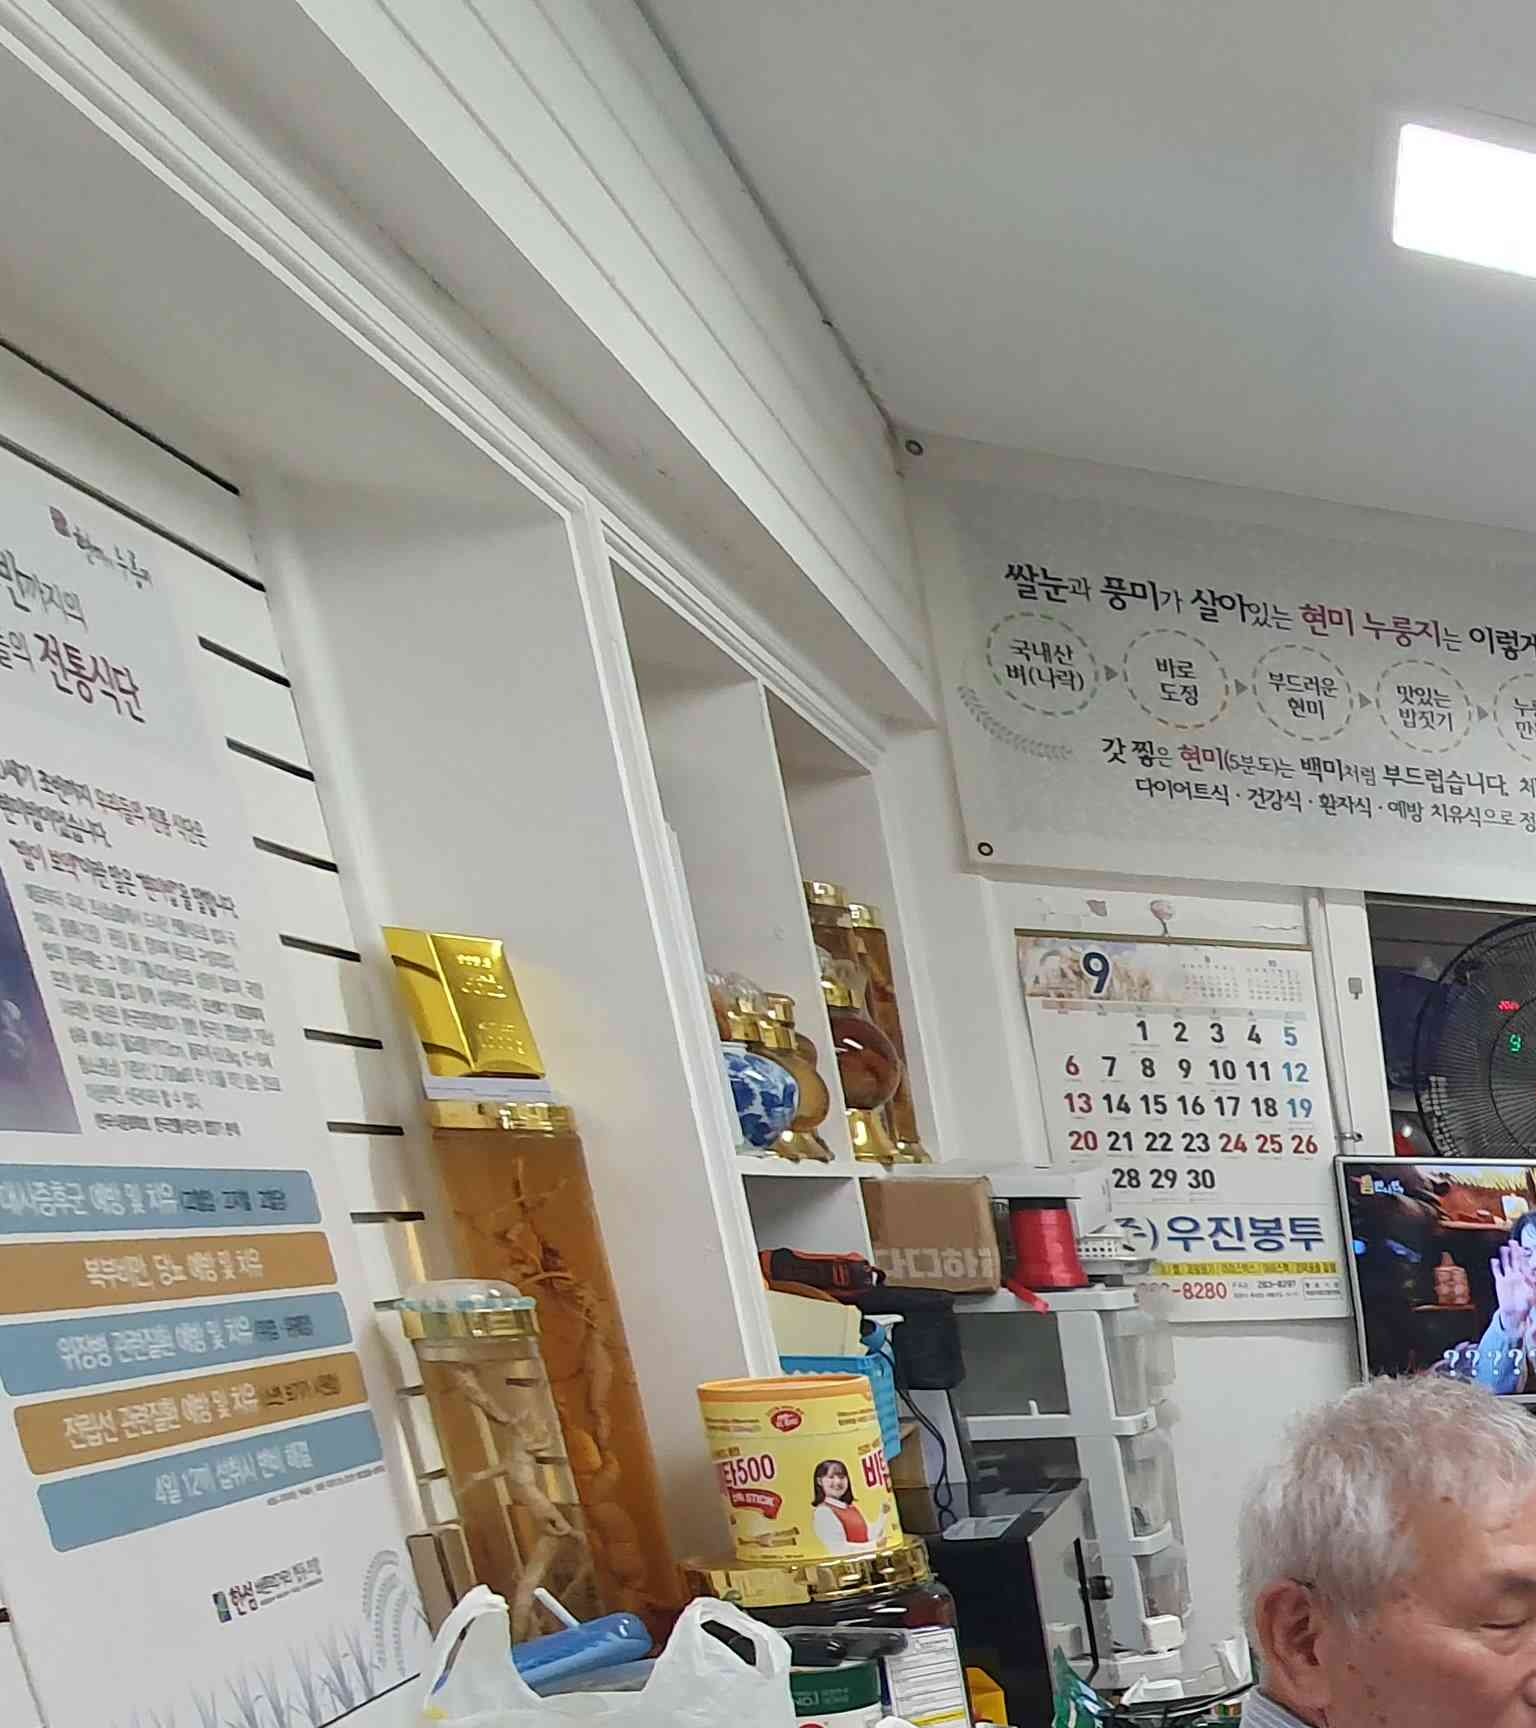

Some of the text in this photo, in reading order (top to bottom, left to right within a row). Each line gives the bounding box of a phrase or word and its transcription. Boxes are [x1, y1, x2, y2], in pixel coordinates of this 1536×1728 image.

[1004, 562, 1091, 604] 쌀눈과
[1100, 574, 1183, 615] 풍미가
[1189, 587, 1293, 632] 살아있는
[1300, 602, 1354, 638] 현미
[1362, 611, 1463, 653] 누룽지는
[1009, 639, 1074, 666] 국내산
[1005, 662, 1086, 693] 벼(나락)
[1154, 655, 1197, 682] 바로
[1159, 681, 1200, 707] 도정
[1267, 670, 1339, 699] 부드러운
[1395, 684, 1452, 709] 맛있는
[1286, 695, 1326, 721] 현미
[1398, 704, 1455, 733] 밥짓기
[1101, 737, 1127, 765] 갓
[1300, 756, 1377, 788] 백미처럼
[1382, 763, 1510, 798] 부드럽습니다.
[1135, 777, 1231, 807] 다이어트식
[1247, 786, 1303, 813] 건강식
[1318, 792, 1373, 819] 환자식
[1387, 799, 1425, 824] 예방
[1430, 803, 1517, 829] 치유식으로
[1082, 950, 1113, 995] 9
[1136, 1020, 1298, 1047] 1 2 3 4 5
[1065, 1055, 1308, 1084] 6 7 8 9 10 11 12
[1064, 1092, 1313, 1120] 13 14 15 16 17 18 19
[1069, 1131, 1319, 1156] 20 21 22 23 24 25 26
[1112, 1168, 1216, 1190] 28 29 30
[717, 1453, 776, 1489] 타500
